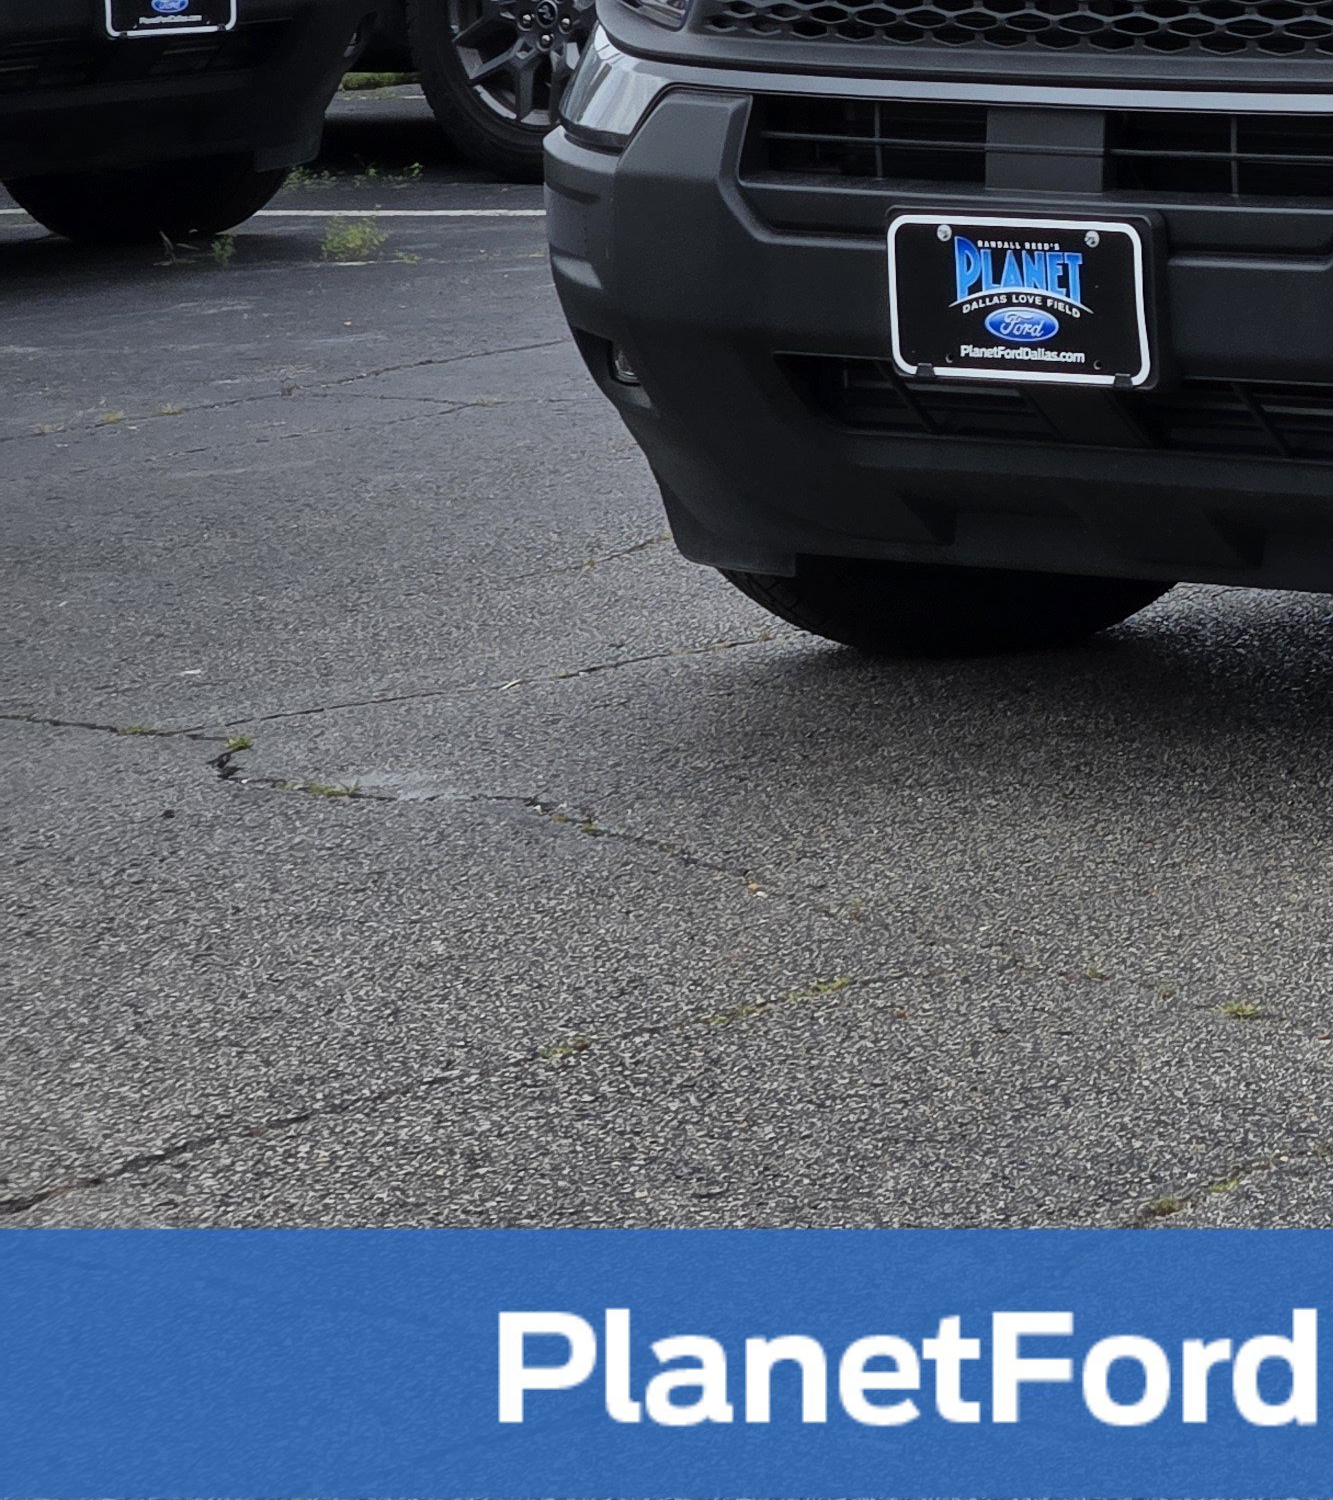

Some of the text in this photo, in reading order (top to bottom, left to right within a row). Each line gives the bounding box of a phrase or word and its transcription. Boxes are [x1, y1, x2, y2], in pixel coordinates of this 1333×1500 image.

[954, 235, 1083, 304] PLANET
[962, 294, 1081, 318] DALLAS LOVE FIELD
[999, 312, 1046, 338] Ford
[960, 345, 1085, 363] PlanetFordDallas.com
